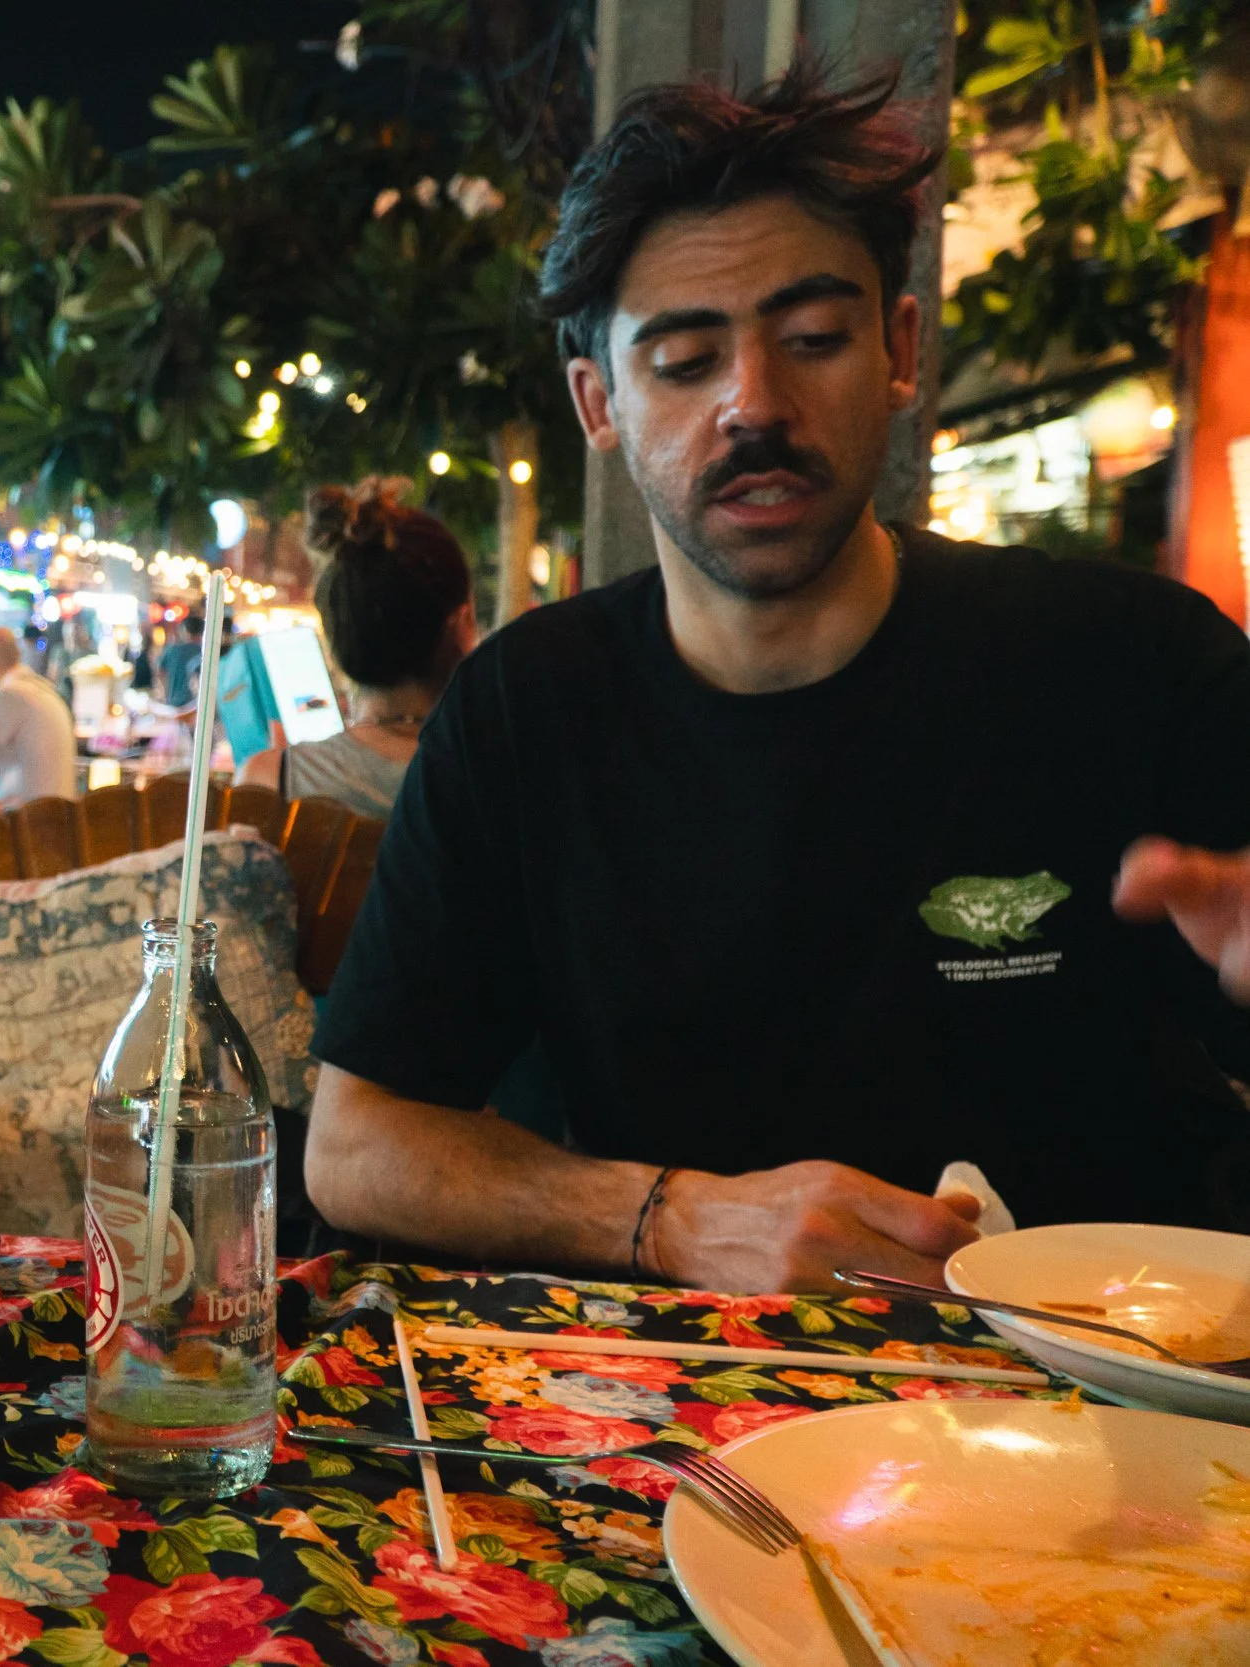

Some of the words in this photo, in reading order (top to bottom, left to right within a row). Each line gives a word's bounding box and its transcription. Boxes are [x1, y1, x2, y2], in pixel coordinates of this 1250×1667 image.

[937, 959, 1006, 971] ECOLOGICAL
[1008, 951, 1062, 967] RESEARCH
[986, 963, 1056, 979] GOODNATURE
